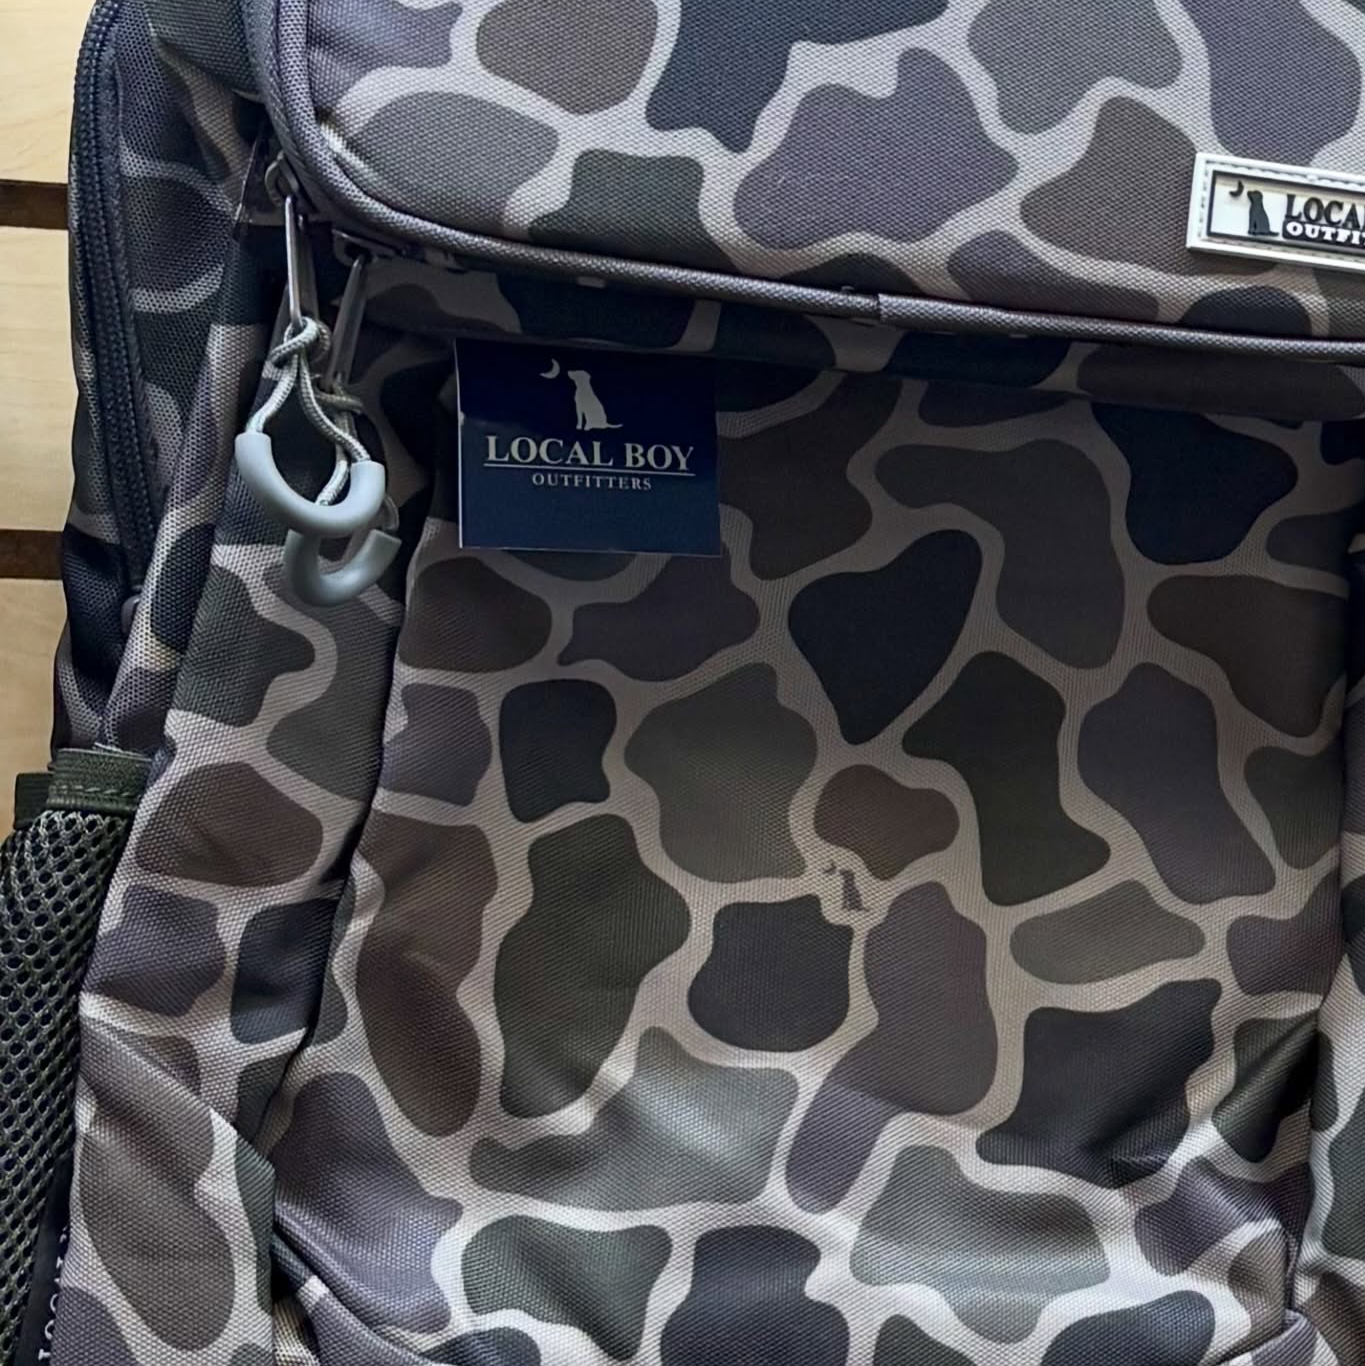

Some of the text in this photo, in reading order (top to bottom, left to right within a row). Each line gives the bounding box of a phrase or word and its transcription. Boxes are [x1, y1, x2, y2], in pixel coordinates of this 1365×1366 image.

[485, 436, 694, 471] LOCAL BOY
[532, 473, 652, 490] OUTFITTERS
